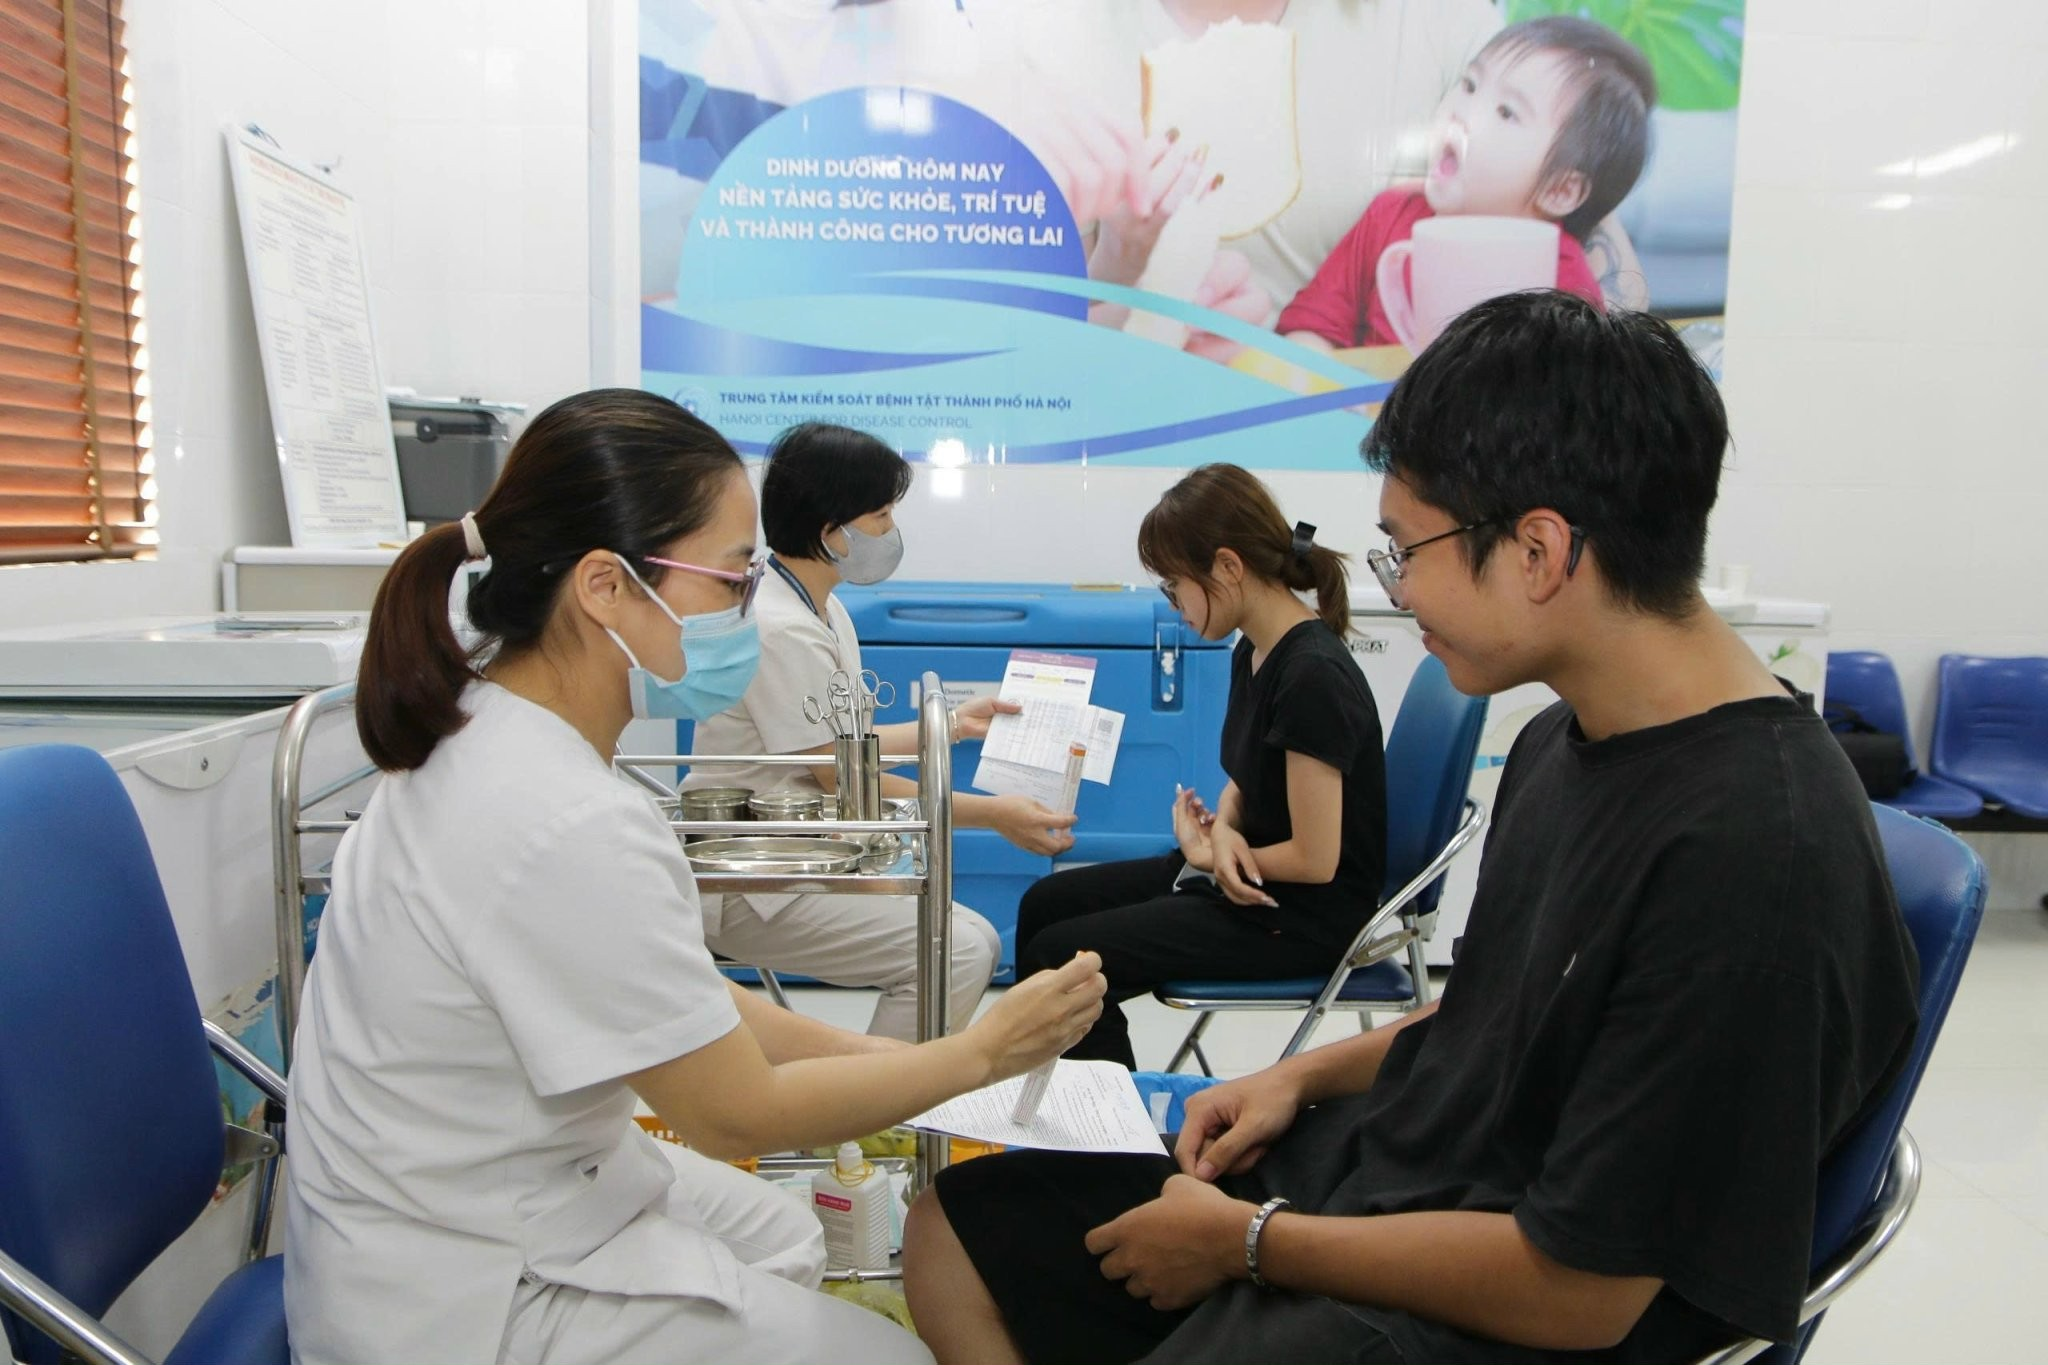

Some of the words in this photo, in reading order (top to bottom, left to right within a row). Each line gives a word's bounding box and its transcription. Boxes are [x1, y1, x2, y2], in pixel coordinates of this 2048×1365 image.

[767, 158, 819, 177] DINH
[907, 157, 956, 181] HÔM
[961, 162, 1005, 183] NAY
[719, 180, 765, 208] NỀN
[772, 182, 833, 209] TẢNG
[838, 186, 884, 210] SỨC
[889, 186, 957, 216] KHỎE,
[961, 188, 998, 214] TRÍ
[1002, 190, 1046, 220] TUỆ
[701, 215, 730, 239] VÀ
[736, 216, 814, 240] THÀNH
[819, 217, 885, 242] CÔNG
[890, 223, 939, 244] CHO
[943, 223, 1024, 245] TƯƠNG
[1029, 225, 1063, 247] LAI
[720, 392, 766, 405] TRUNG
[770, 391, 798, 405] TÂM
[801, 390, 833, 406] KIỂM
[837, 391, 873, 406] SOÁT
[876, 392, 913, 408] BỆNH
[917, 393, 940, 410] TẬT
[945, 393, 991, 409] THÀNH
[995, 393, 1023, 409] PHỐ
[1025, 395, 1044, 409] HÀ
[1047, 396, 1071, 412] NỘI
[719, 414, 762, 425] HANOI
[765, 414, 820, 426] CENTER
[823, 415, 848, 426] FOR
[851, 415, 905, 428] DISEASE
[908, 416, 972, 429] CONTROL
